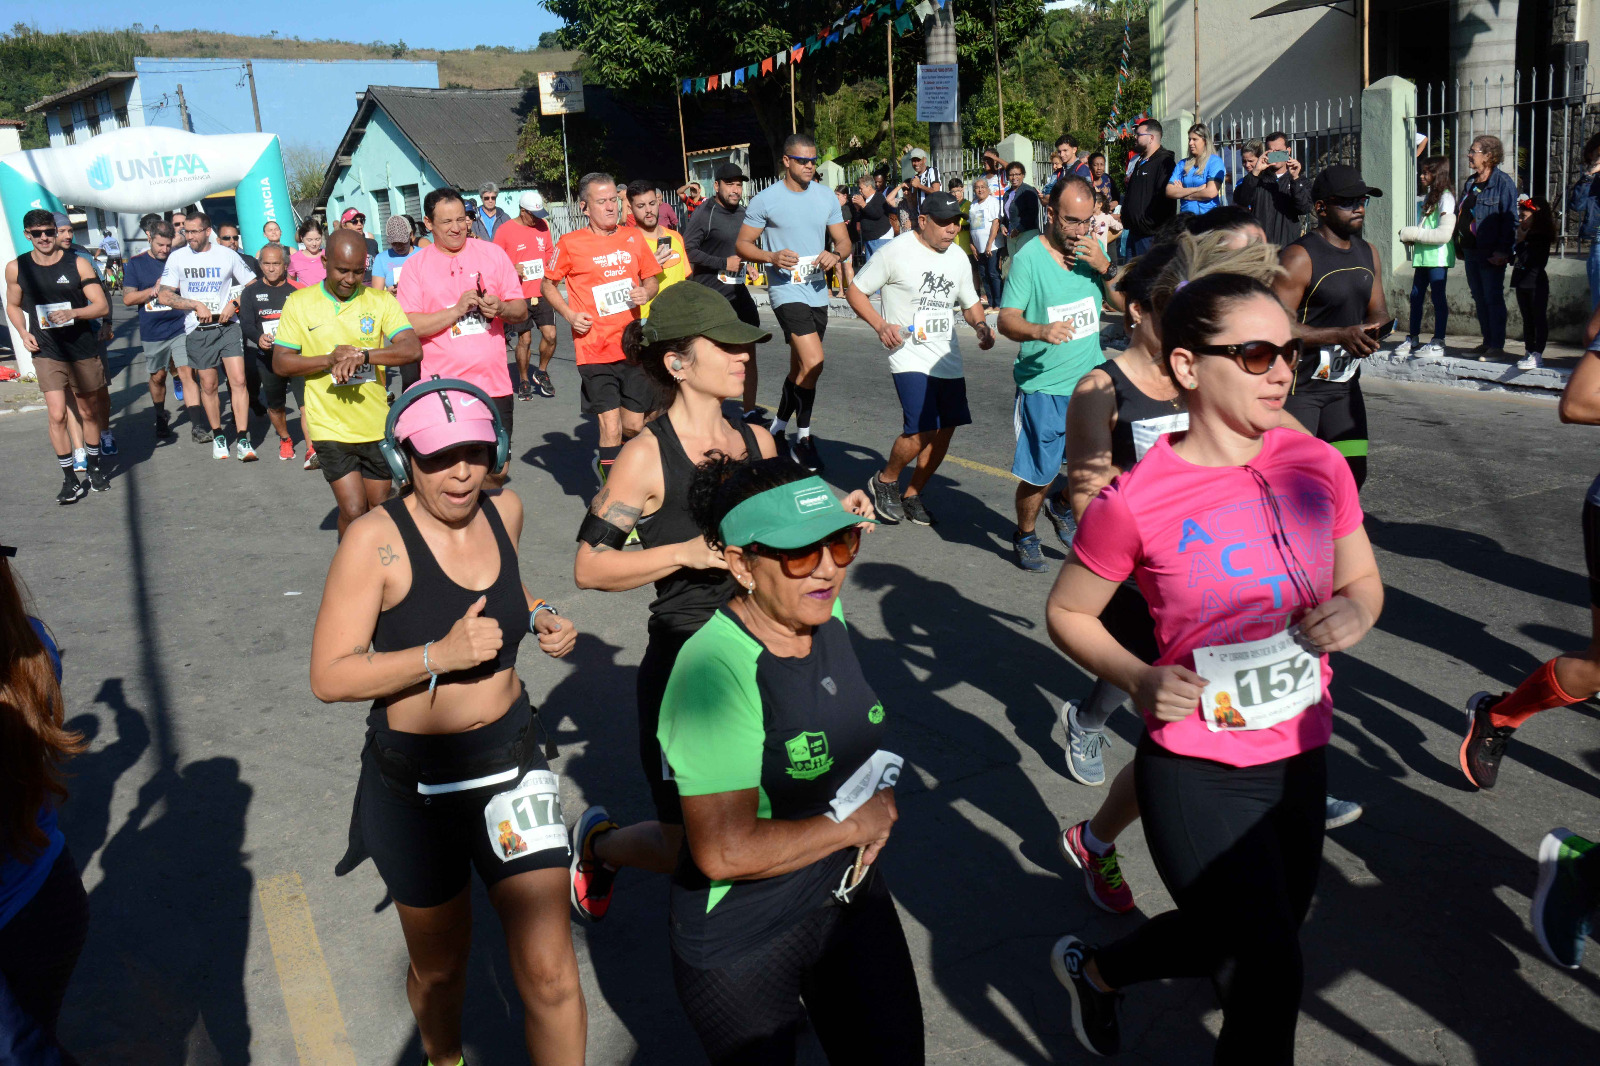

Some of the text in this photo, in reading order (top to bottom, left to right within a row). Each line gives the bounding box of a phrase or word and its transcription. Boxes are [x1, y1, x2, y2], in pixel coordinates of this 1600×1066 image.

[184, 267, 221, 278] PROFIT
[604, 268, 624, 277] Claro
[606, 287, 631, 305] 109
[926, 318, 949, 333] 113
[1178, 492, 1331, 553] ACTIVE
[1188, 528, 1333, 588] ACTIVE
[1239, 653, 1315, 705] 152
